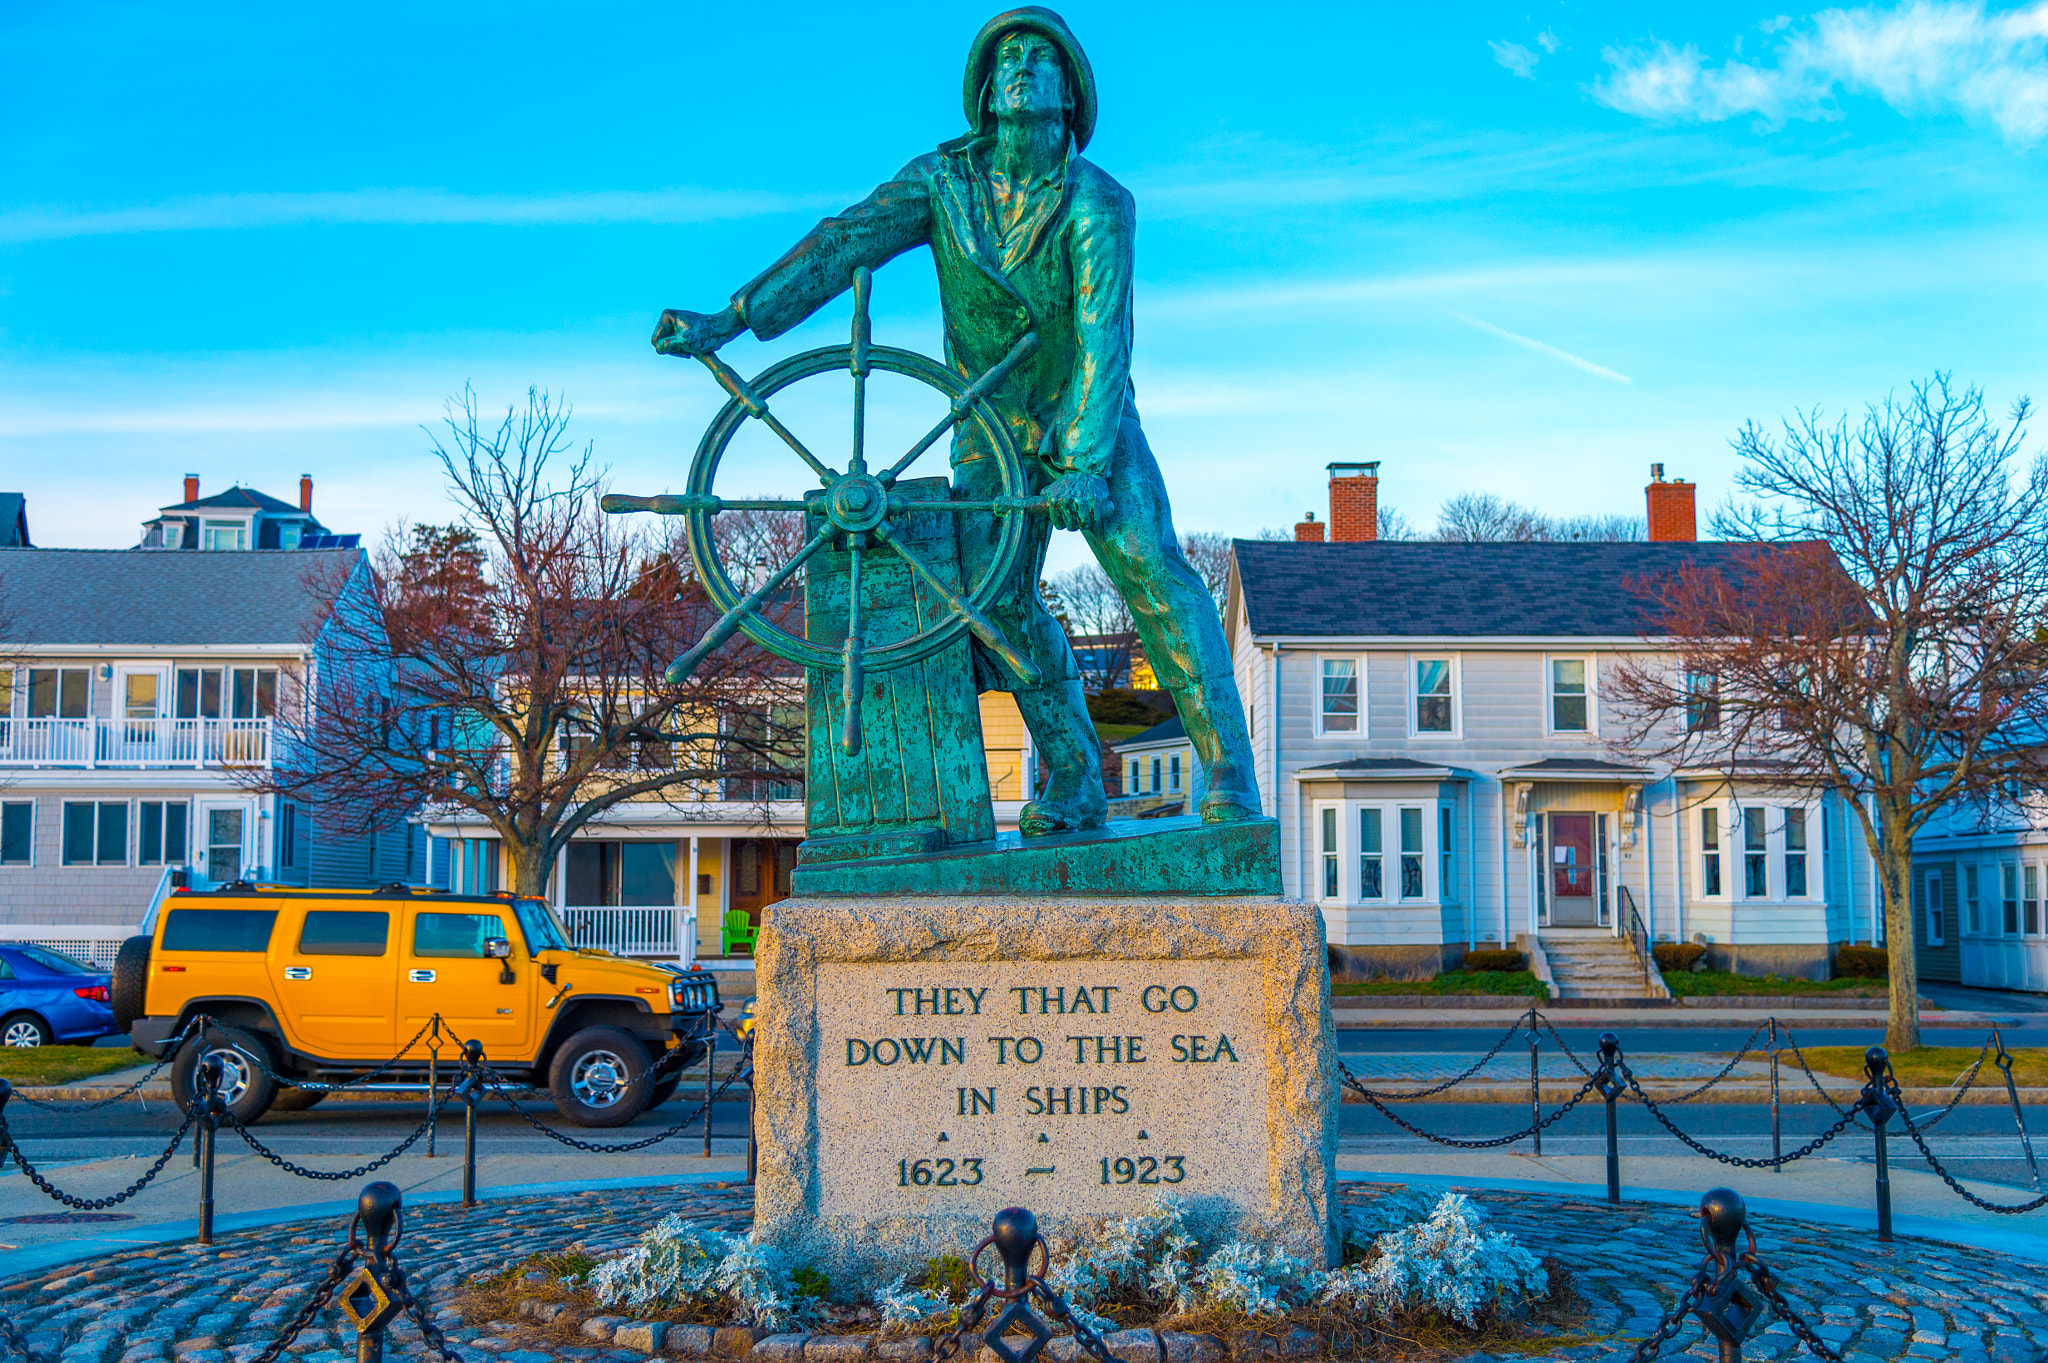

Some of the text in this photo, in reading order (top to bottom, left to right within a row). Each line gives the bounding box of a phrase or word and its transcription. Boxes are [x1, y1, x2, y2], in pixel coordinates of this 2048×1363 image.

[886, 985, 1198, 1016] THEY THAT GO
[846, 1034, 1239, 1067] DOWN TO THE SEA
[957, 1085, 1129, 1116] IN SHIPS
[898, 1157, 984, 1187] 1623
[1100, 1155, 1186, 1185] 1923
